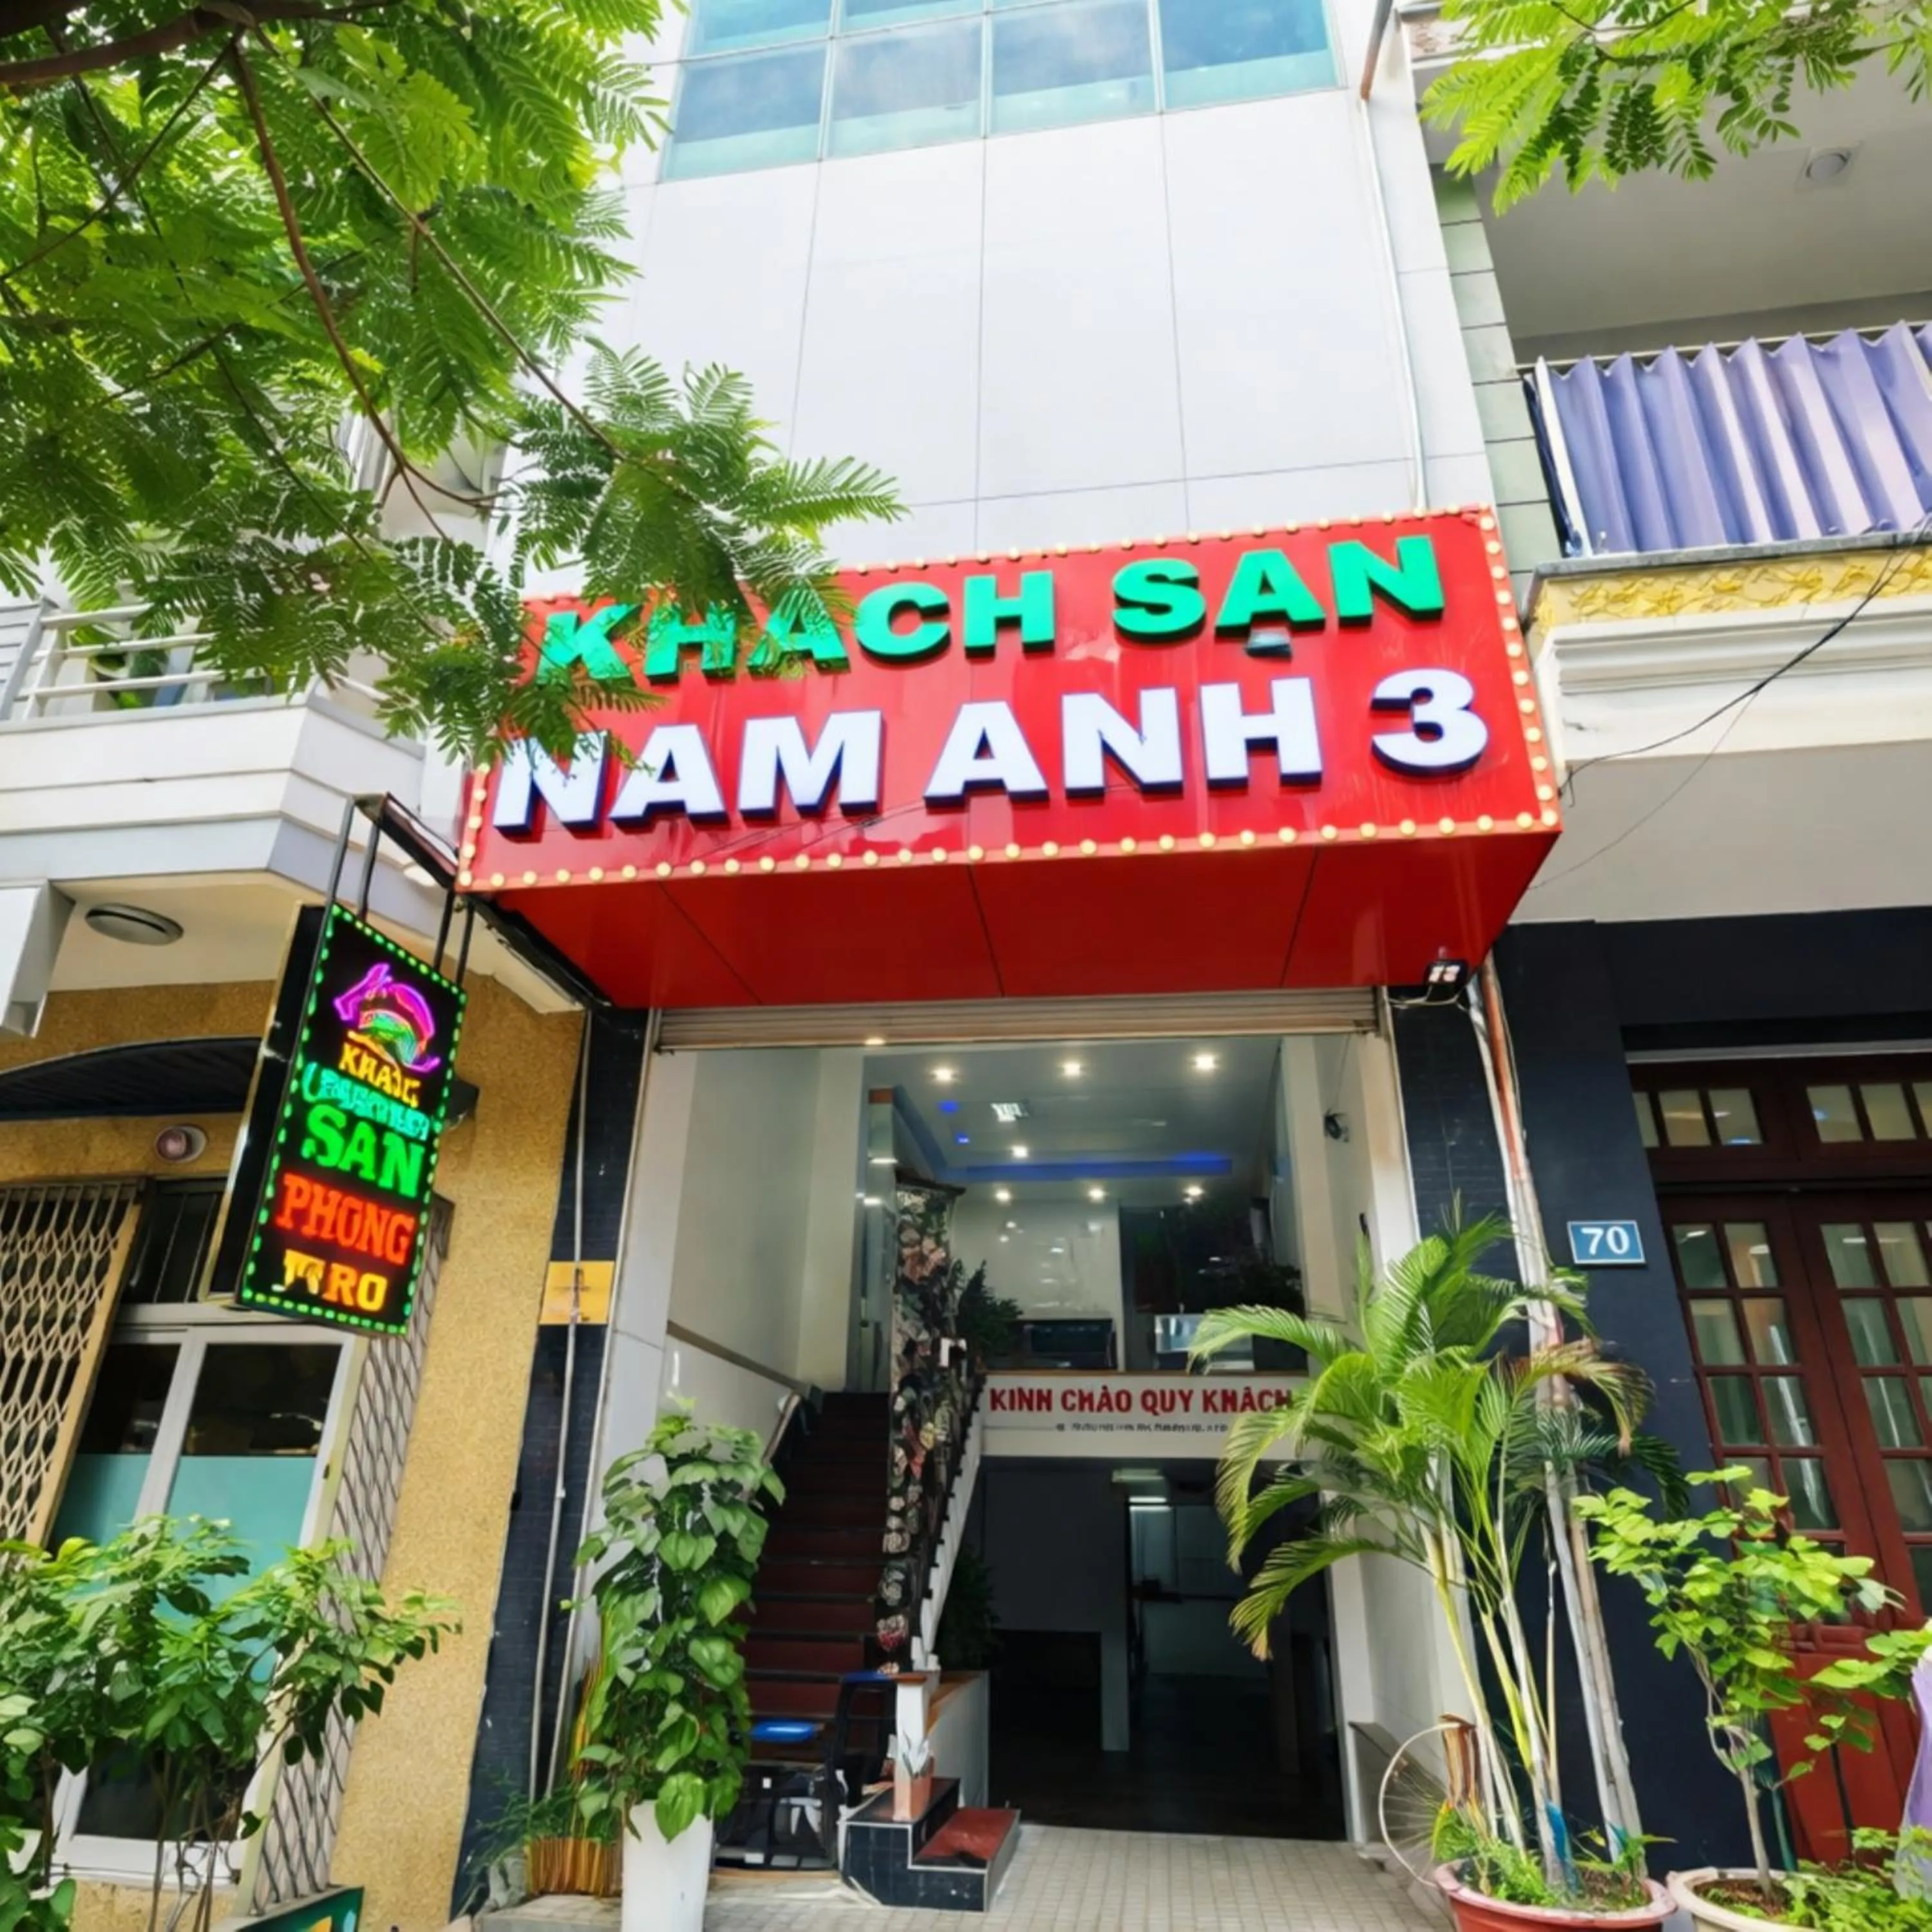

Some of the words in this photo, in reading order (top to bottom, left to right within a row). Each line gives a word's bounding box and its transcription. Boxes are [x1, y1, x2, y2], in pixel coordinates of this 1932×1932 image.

[492, 709, 884, 833] NAM
[924, 677, 1323, 806] ANH
[1370, 668, 1489, 775] 3
[301, 1104, 425, 1198] SAN
[276, 1173, 415, 1265] PHONG
[1581, 1226, 1630, 1256] 70
